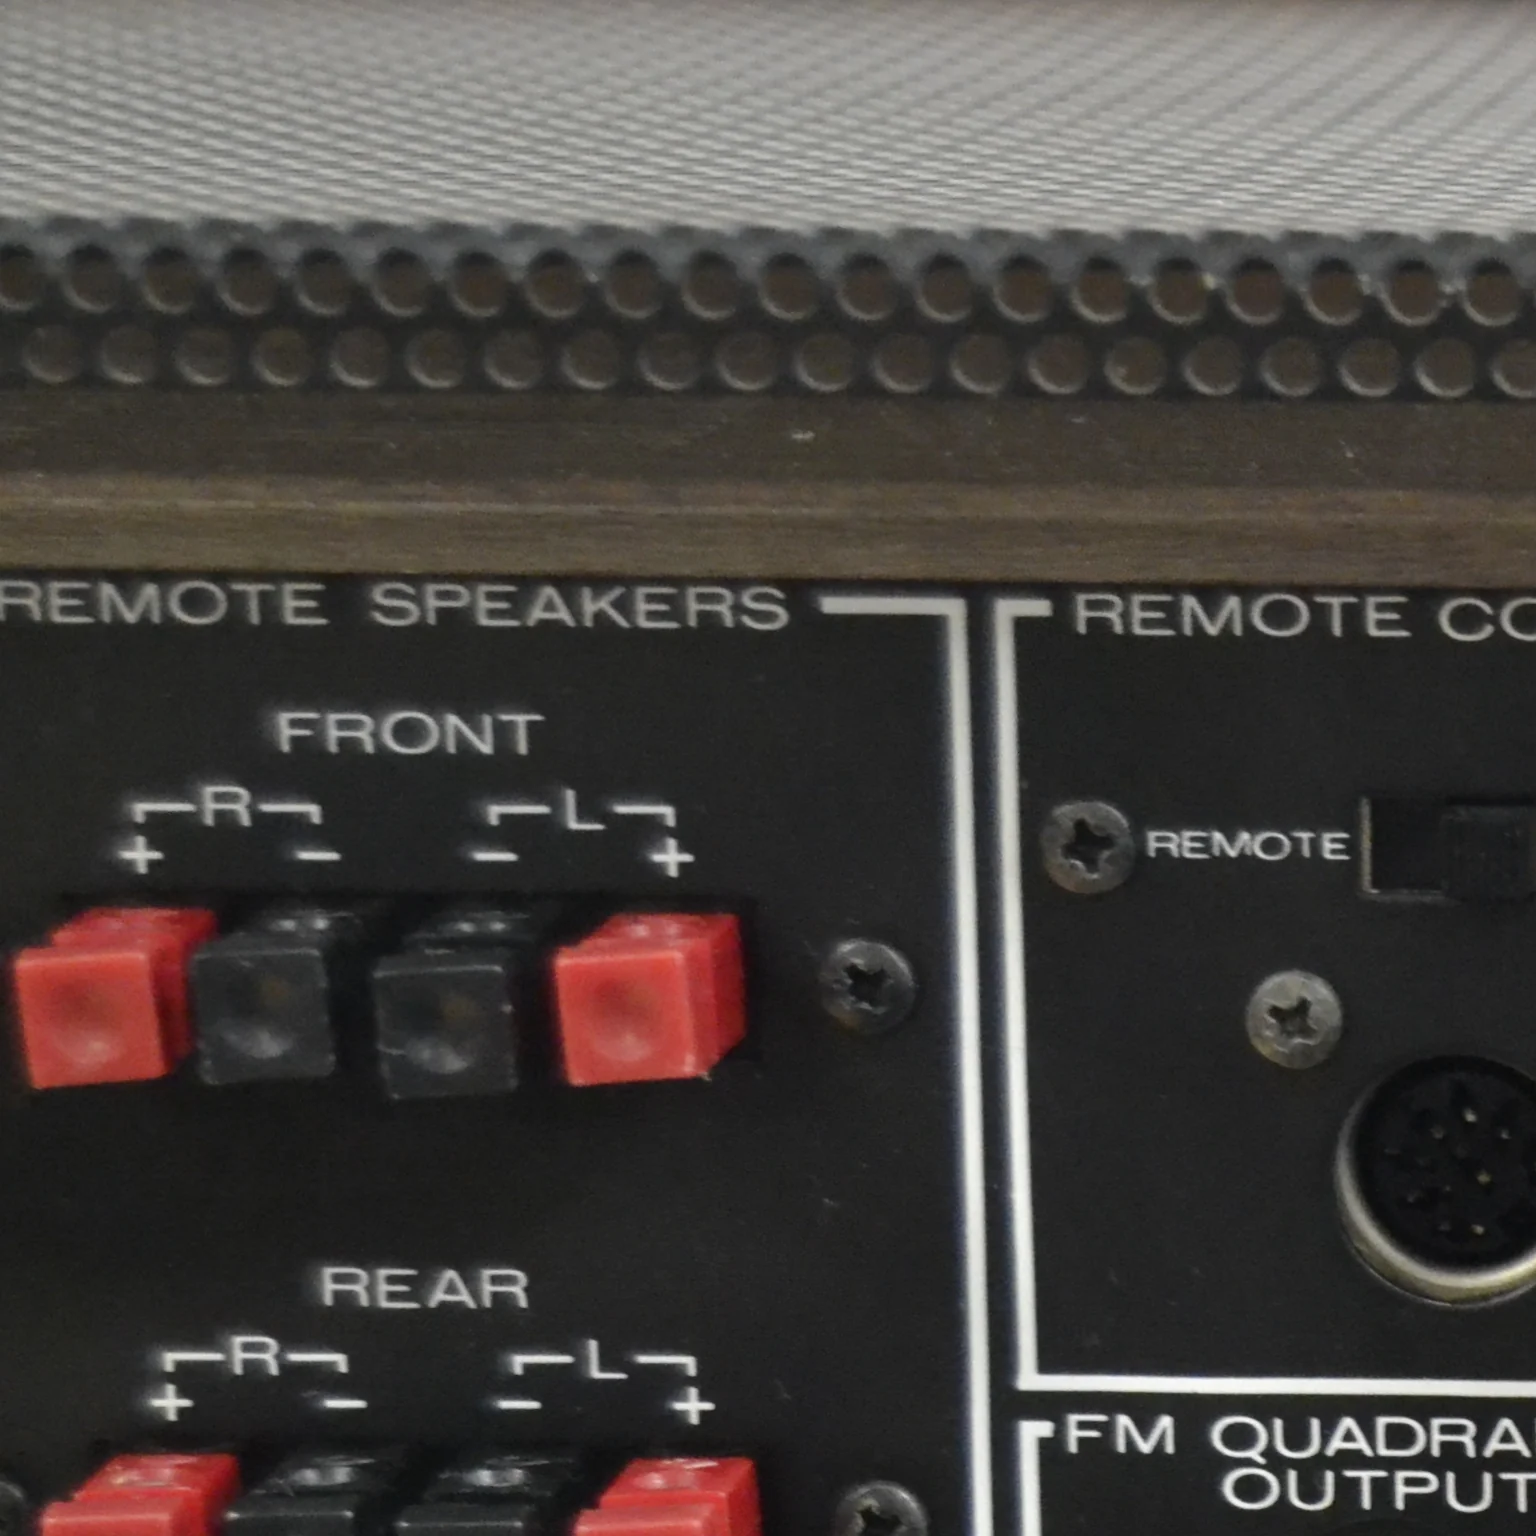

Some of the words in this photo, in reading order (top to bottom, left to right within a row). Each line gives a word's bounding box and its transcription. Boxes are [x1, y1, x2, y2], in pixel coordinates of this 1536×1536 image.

[0, 579, 329, 626] REMOTE
[370, 581, 790, 631] SPEAKERS
[1075, 592, 1411, 638] REMOTE
[274, 710, 545, 755] FRONT
[200, 784, 252, 827] R
[564, 788, 606, 831] L
[1146, 830, 1350, 861] REMOTE
[321, 1266, 529, 1309] REAR
[229, 1335, 279, 1376] R
[586, 1338, 628, 1380] L
[1066, 1413, 1175, 1455] FM
